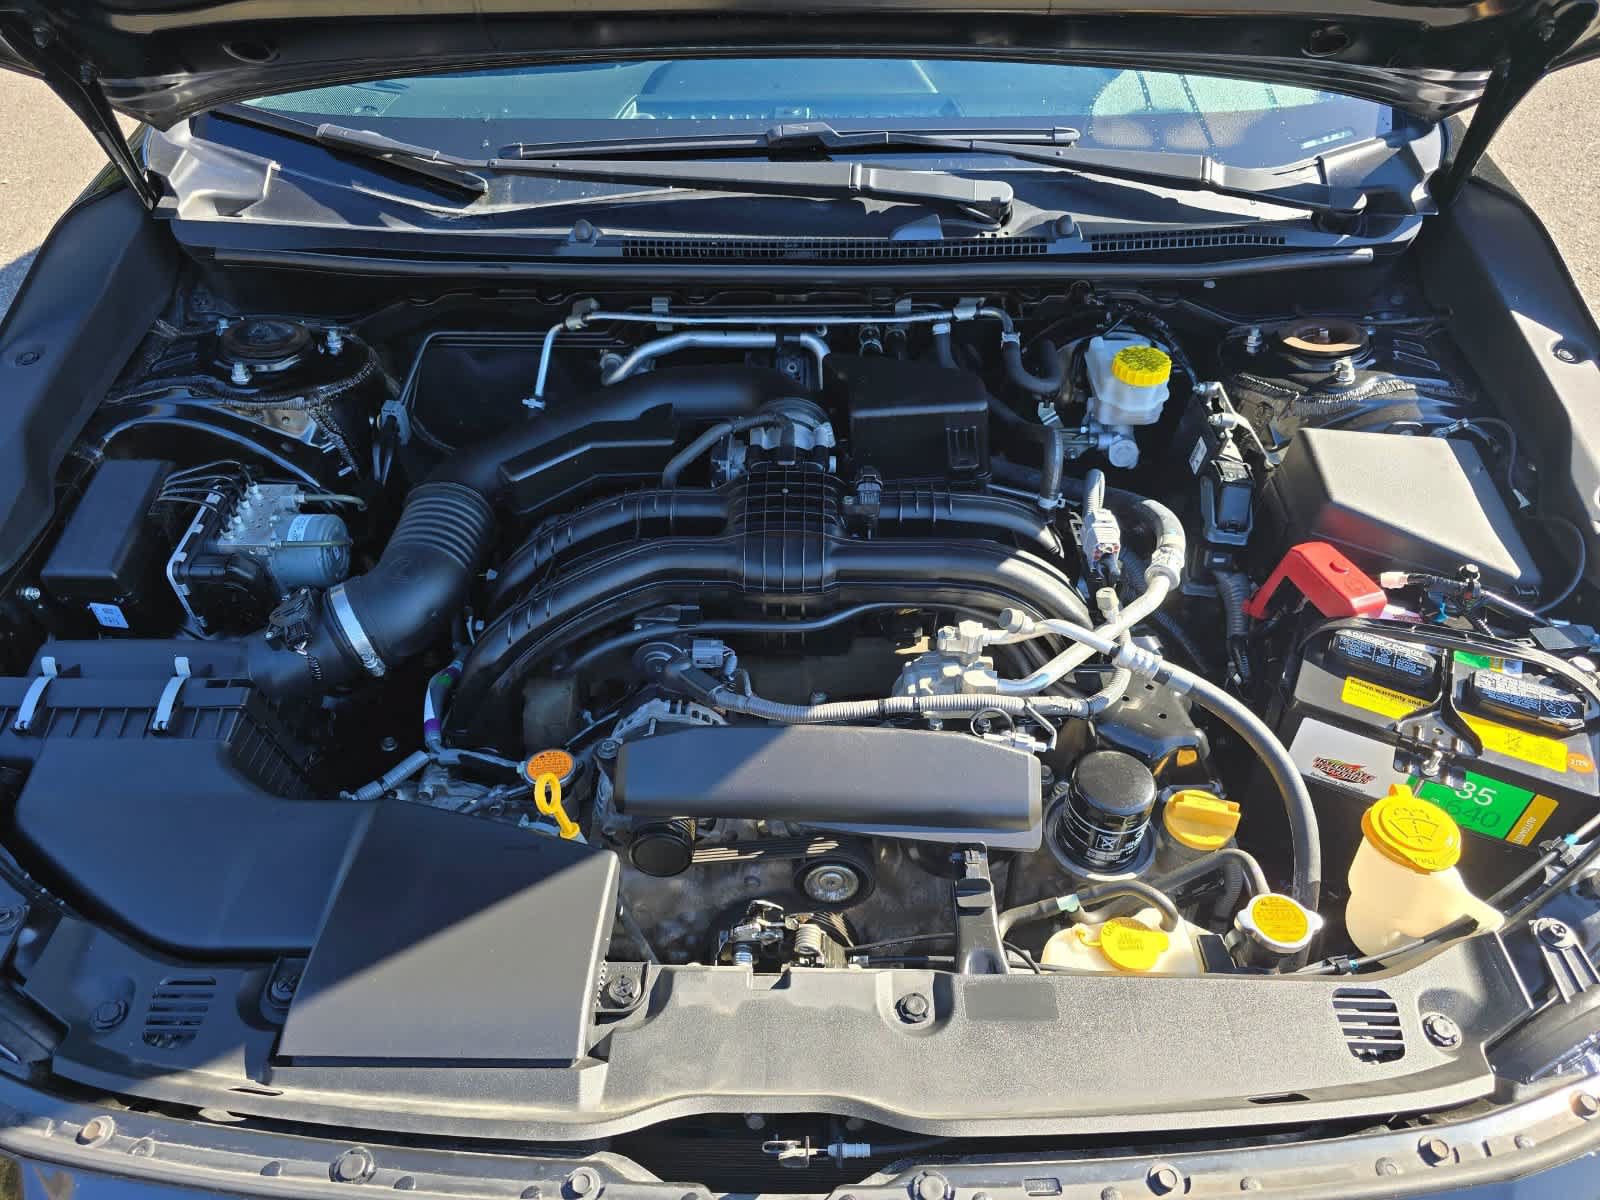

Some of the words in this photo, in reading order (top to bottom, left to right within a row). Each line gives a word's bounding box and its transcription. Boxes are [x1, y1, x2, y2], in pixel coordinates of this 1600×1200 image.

[1375, 687, 1406, 702] warranty
[1454, 781, 1497, 806] 35
[1446, 800, 1500, 828] 640
